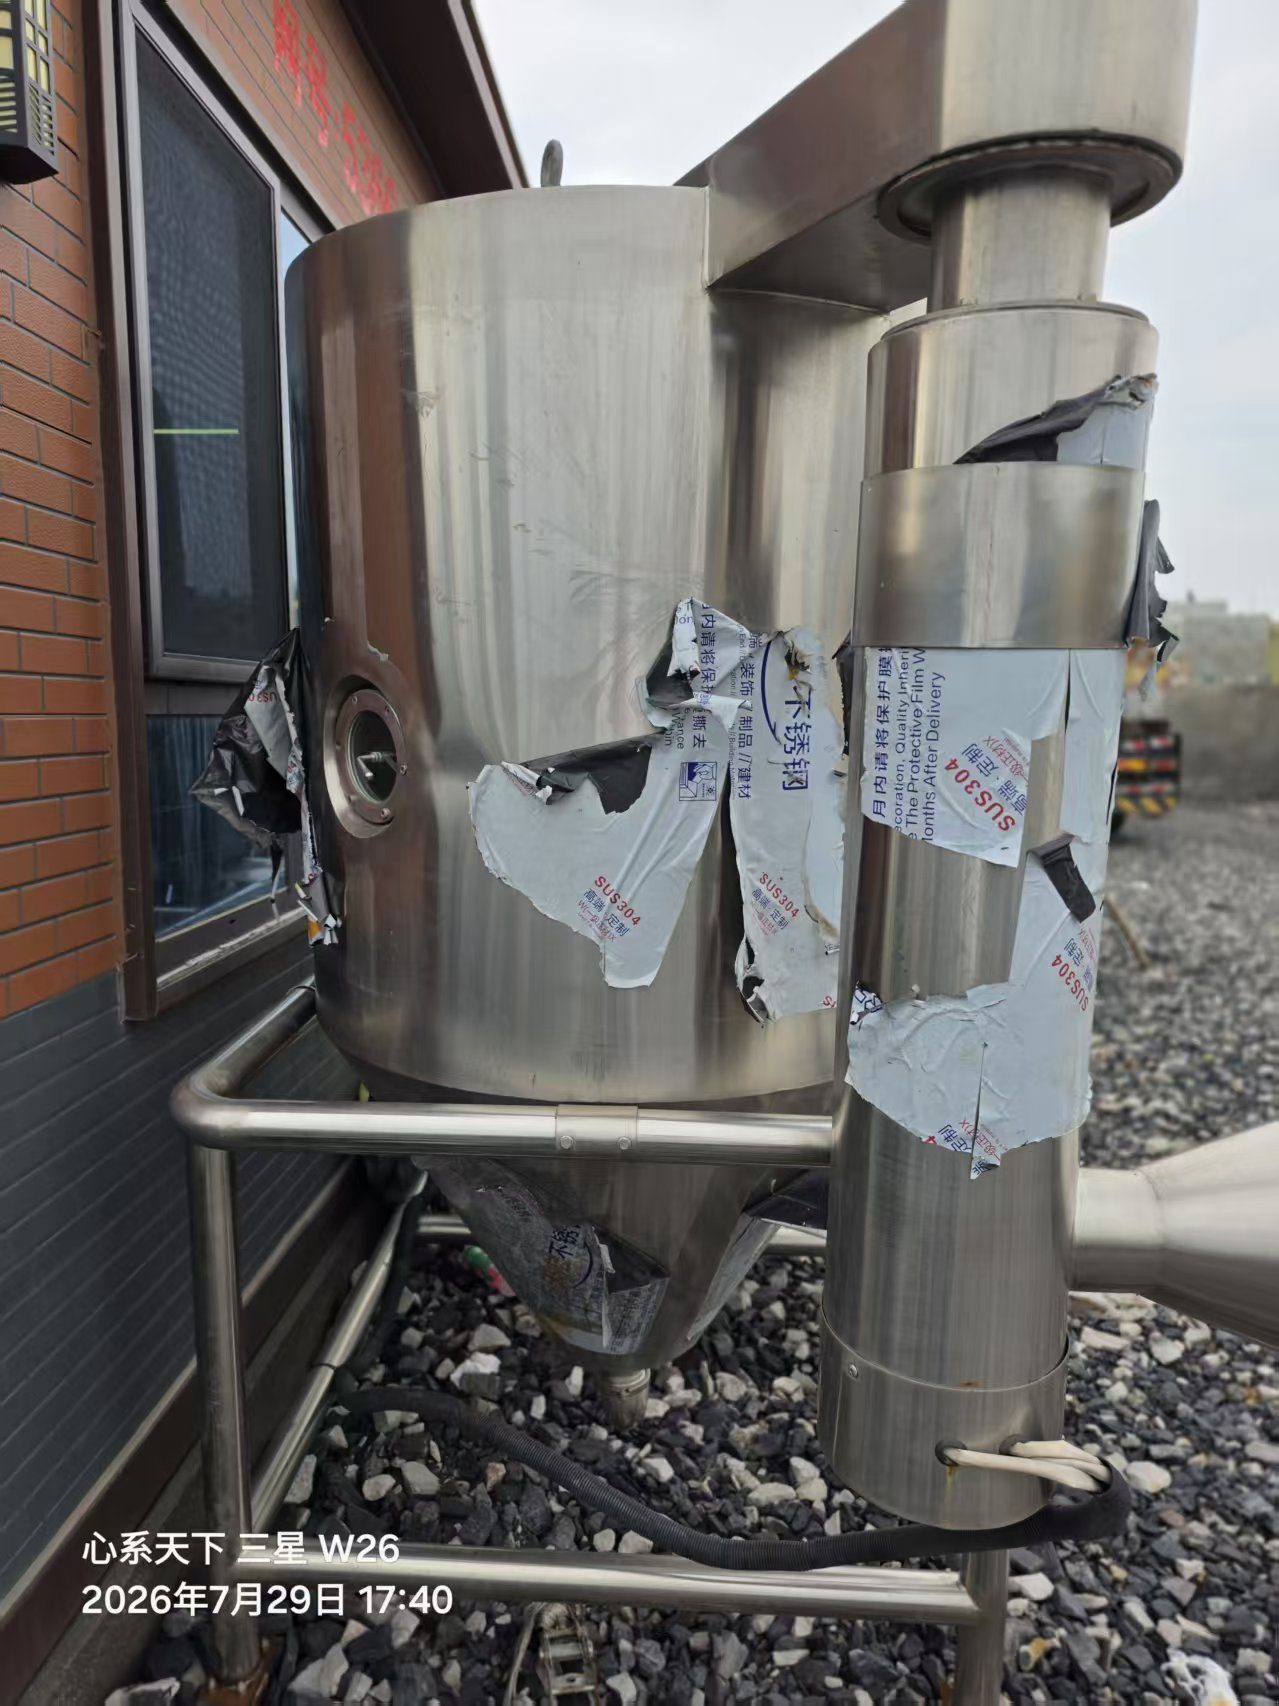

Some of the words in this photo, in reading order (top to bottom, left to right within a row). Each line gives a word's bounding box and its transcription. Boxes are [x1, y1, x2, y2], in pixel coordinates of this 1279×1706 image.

[897, 648, 910, 694] Inheri
[910, 668, 925, 703] Film
[872, 648, 893, 818] 月内请将保护膜
[895, 699, 910, 754] Quality
[926, 671, 945, 742] Delivery
[782, 686, 812, 791] 不锈钢
[906, 708, 923, 793] Protective
[923, 745, 938, 787] After
[905, 797, 919, 827] The
[921, 791, 936, 841] onths
[944, 757, 1016, 832] SUS304
[594, 874, 641, 927] SUS304
[759, 873, 800, 918] SUS304
[1051, 953, 1089, 1011] SUS304
